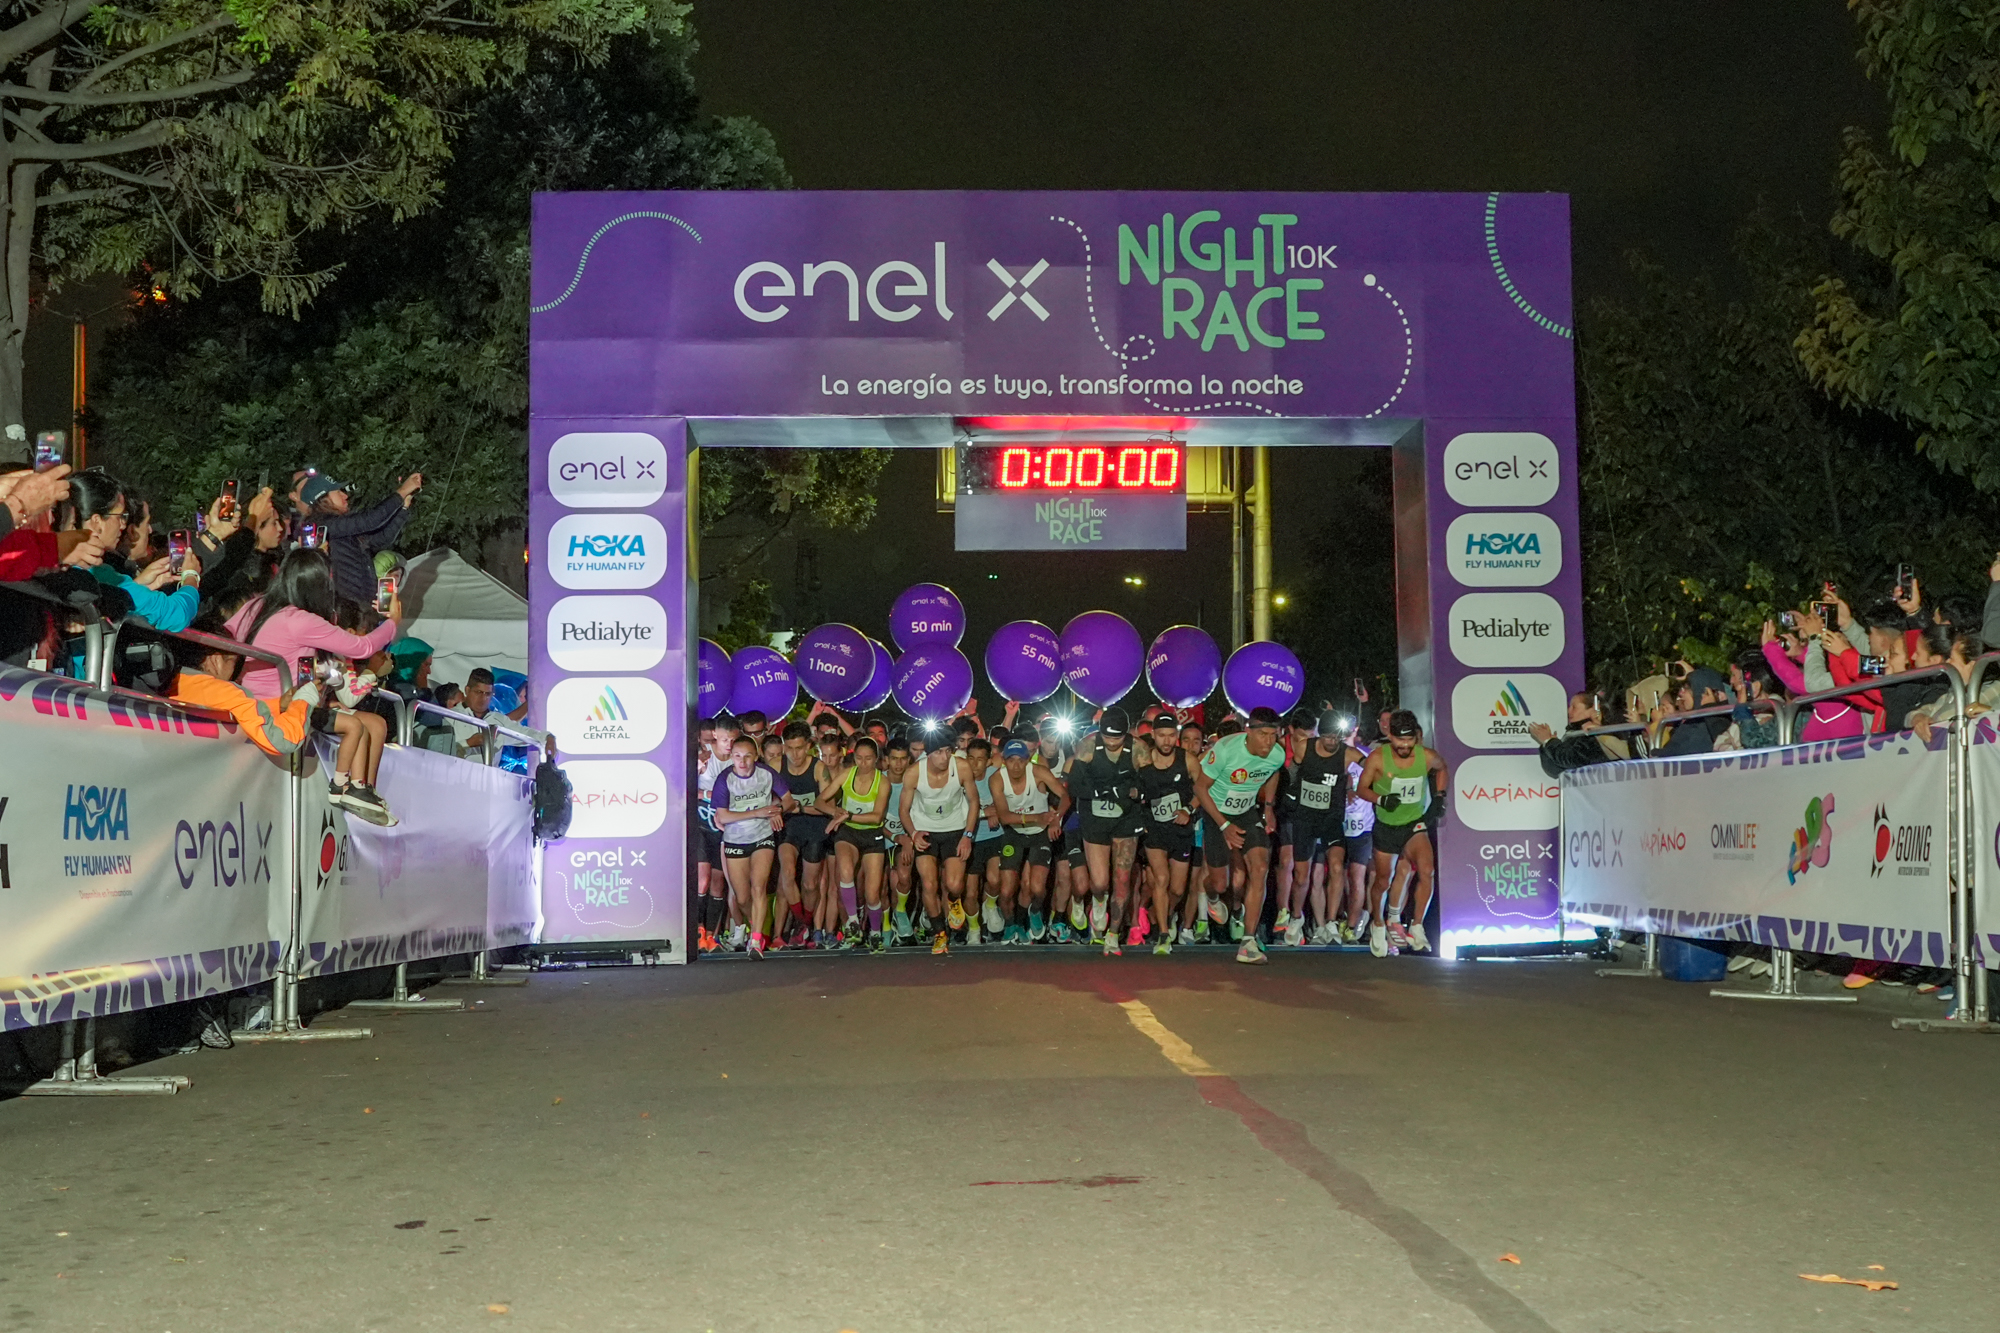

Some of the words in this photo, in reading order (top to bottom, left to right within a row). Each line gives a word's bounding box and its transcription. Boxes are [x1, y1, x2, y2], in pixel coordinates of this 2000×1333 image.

[1118, 210, 1298, 288] NIGHT
[1288, 245, 1337, 269] 10K
[734, 241, 954, 322] enel
[1162, 277, 1325, 352] RACE
[821, 375, 849, 396] La
[857, 373, 952, 400] energía
[960, 379, 987, 396] es
[995, 376, 1053, 400] tuya,
[1059, 374, 1193, 396] transforma
[1201, 375, 1224, 396] la
[1231, 374, 1304, 396] noche
[560, 456, 626, 481] enel
[1455, 455, 1520, 480] enel
[1035, 498, 1094, 524] NIGHT
[1090, 508, 1107, 518] 10K
[1050, 519, 1103, 544] RACE
[567, 535, 646, 557] HOKA
[1465, 533, 1541, 555] HOKA
[567, 562, 583, 571] FLY
[586, 562, 626, 571] HUMAN
[628, 562, 646, 571] FLY
[1466, 560, 1481, 568] FLY
[1484, 560, 1523, 568] HUMAN
[1525, 560, 1541, 568] FLY
[561, 621, 652, 645] Pedialyte
[911, 621, 928, 633] 50
[931, 620, 952, 632] min
[1461, 618, 1550, 642] Pedialyte
[809, 657, 815, 670] 1
[816, 658, 847, 677] hora
[1021, 644, 1038, 658] 55
[1038, 653, 1055, 671] min
[1151, 653, 1169, 670] min
[750, 675, 758, 687] 1
[757, 673, 766, 686] h
[765, 670, 774, 683] 5
[774, 669, 790, 681] min
[1069, 666, 1091, 681] min
[1257, 675, 1274, 687] 45
[1275, 680, 1294, 694] min
[911, 690, 927, 706] 50
[925, 671, 946, 693] min
[583, 732, 631, 740] CENTRAL
[1302, 788, 1330, 803] 7668
[1401, 785, 1416, 798] 14
[63, 784, 130, 841] HOKA
[935, 805, 943, 815] 4
[1101, 800, 1115, 811] 20
[1152, 800, 1180, 816] 2617
[175, 802, 247, 889] enel
[1570, 819, 1606, 868] enel
[1711, 823, 1757, 849] OMNILIFE
[1895, 825, 1932, 862] GOING
[570, 847, 623, 867] enel
[1480, 840, 1531, 860] enel
[64, 855, 79, 877] FLY
[81, 855, 118, 876] HUMAN
[117, 855, 132, 874] FLY
[1484, 862, 1531, 883] NIGHT
[574, 869, 622, 891] NIGHT
[619, 877, 633, 886] 10K
[1496, 879, 1538, 900] RACE
[586, 887, 629, 908] RACE
